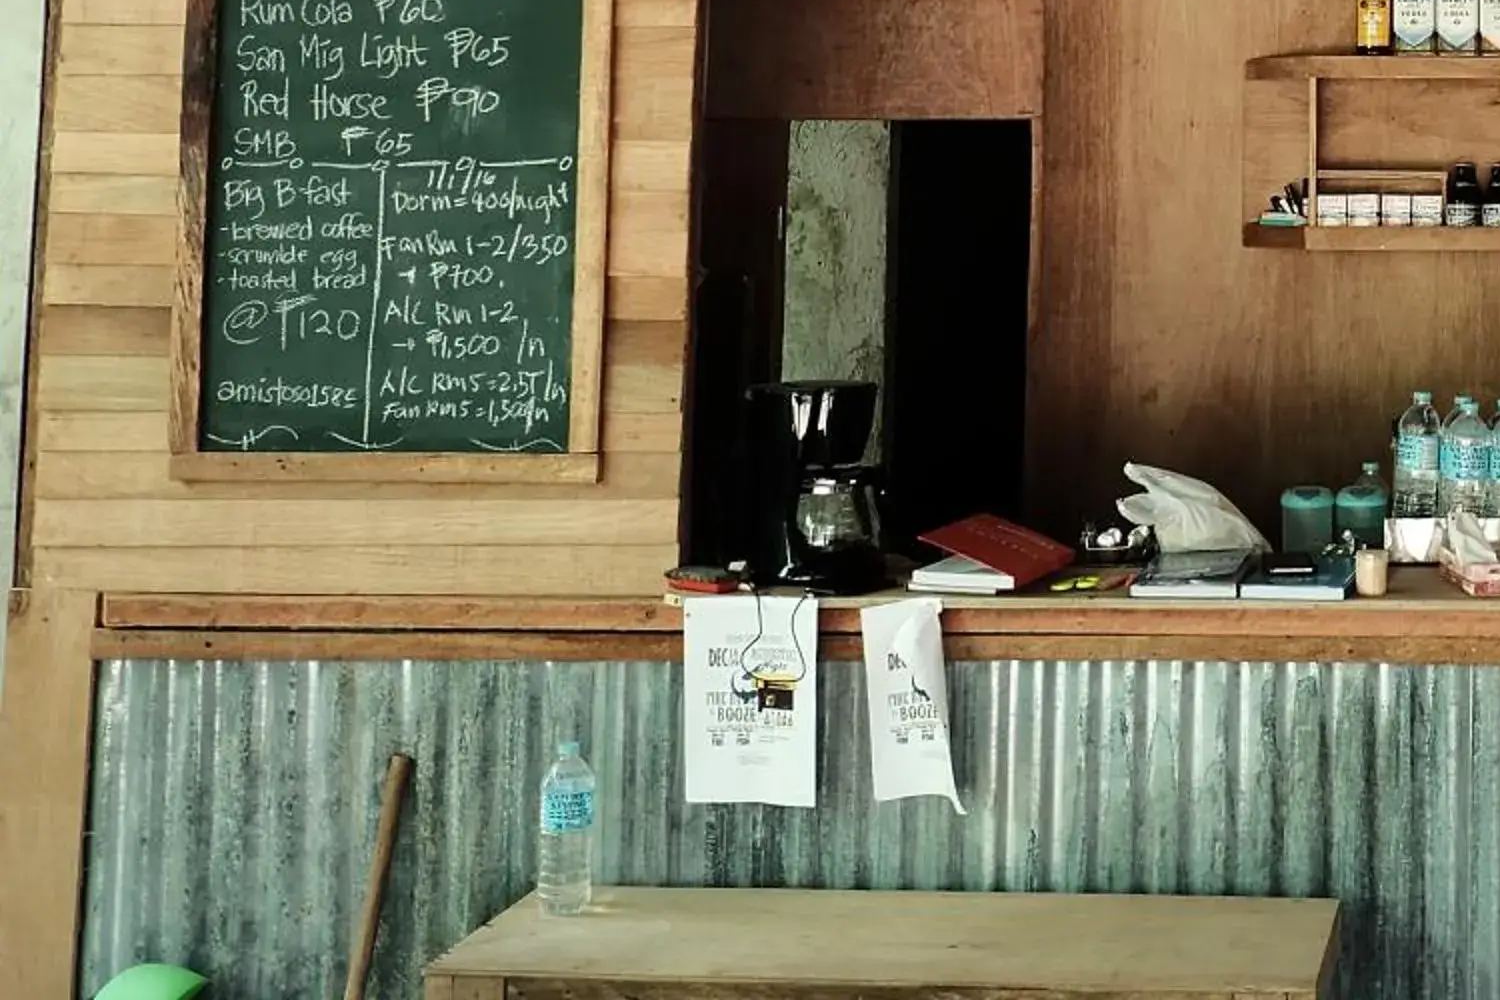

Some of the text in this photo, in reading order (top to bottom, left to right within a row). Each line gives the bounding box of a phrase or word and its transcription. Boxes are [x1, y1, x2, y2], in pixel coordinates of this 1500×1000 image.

[237, 35, 285, 72] San
[300, 33, 344, 80] Mig
[360, 33, 427, 79] Light
[240, 77, 289, 118] Red
[310, 83, 393, 121] Horse
[235, 127, 297, 158] SMB
[224, 179, 266, 221] Big
[321, 212, 374, 240] coffee
[319, 248, 357, 272] egg
[312, 262, 367, 290] bread
